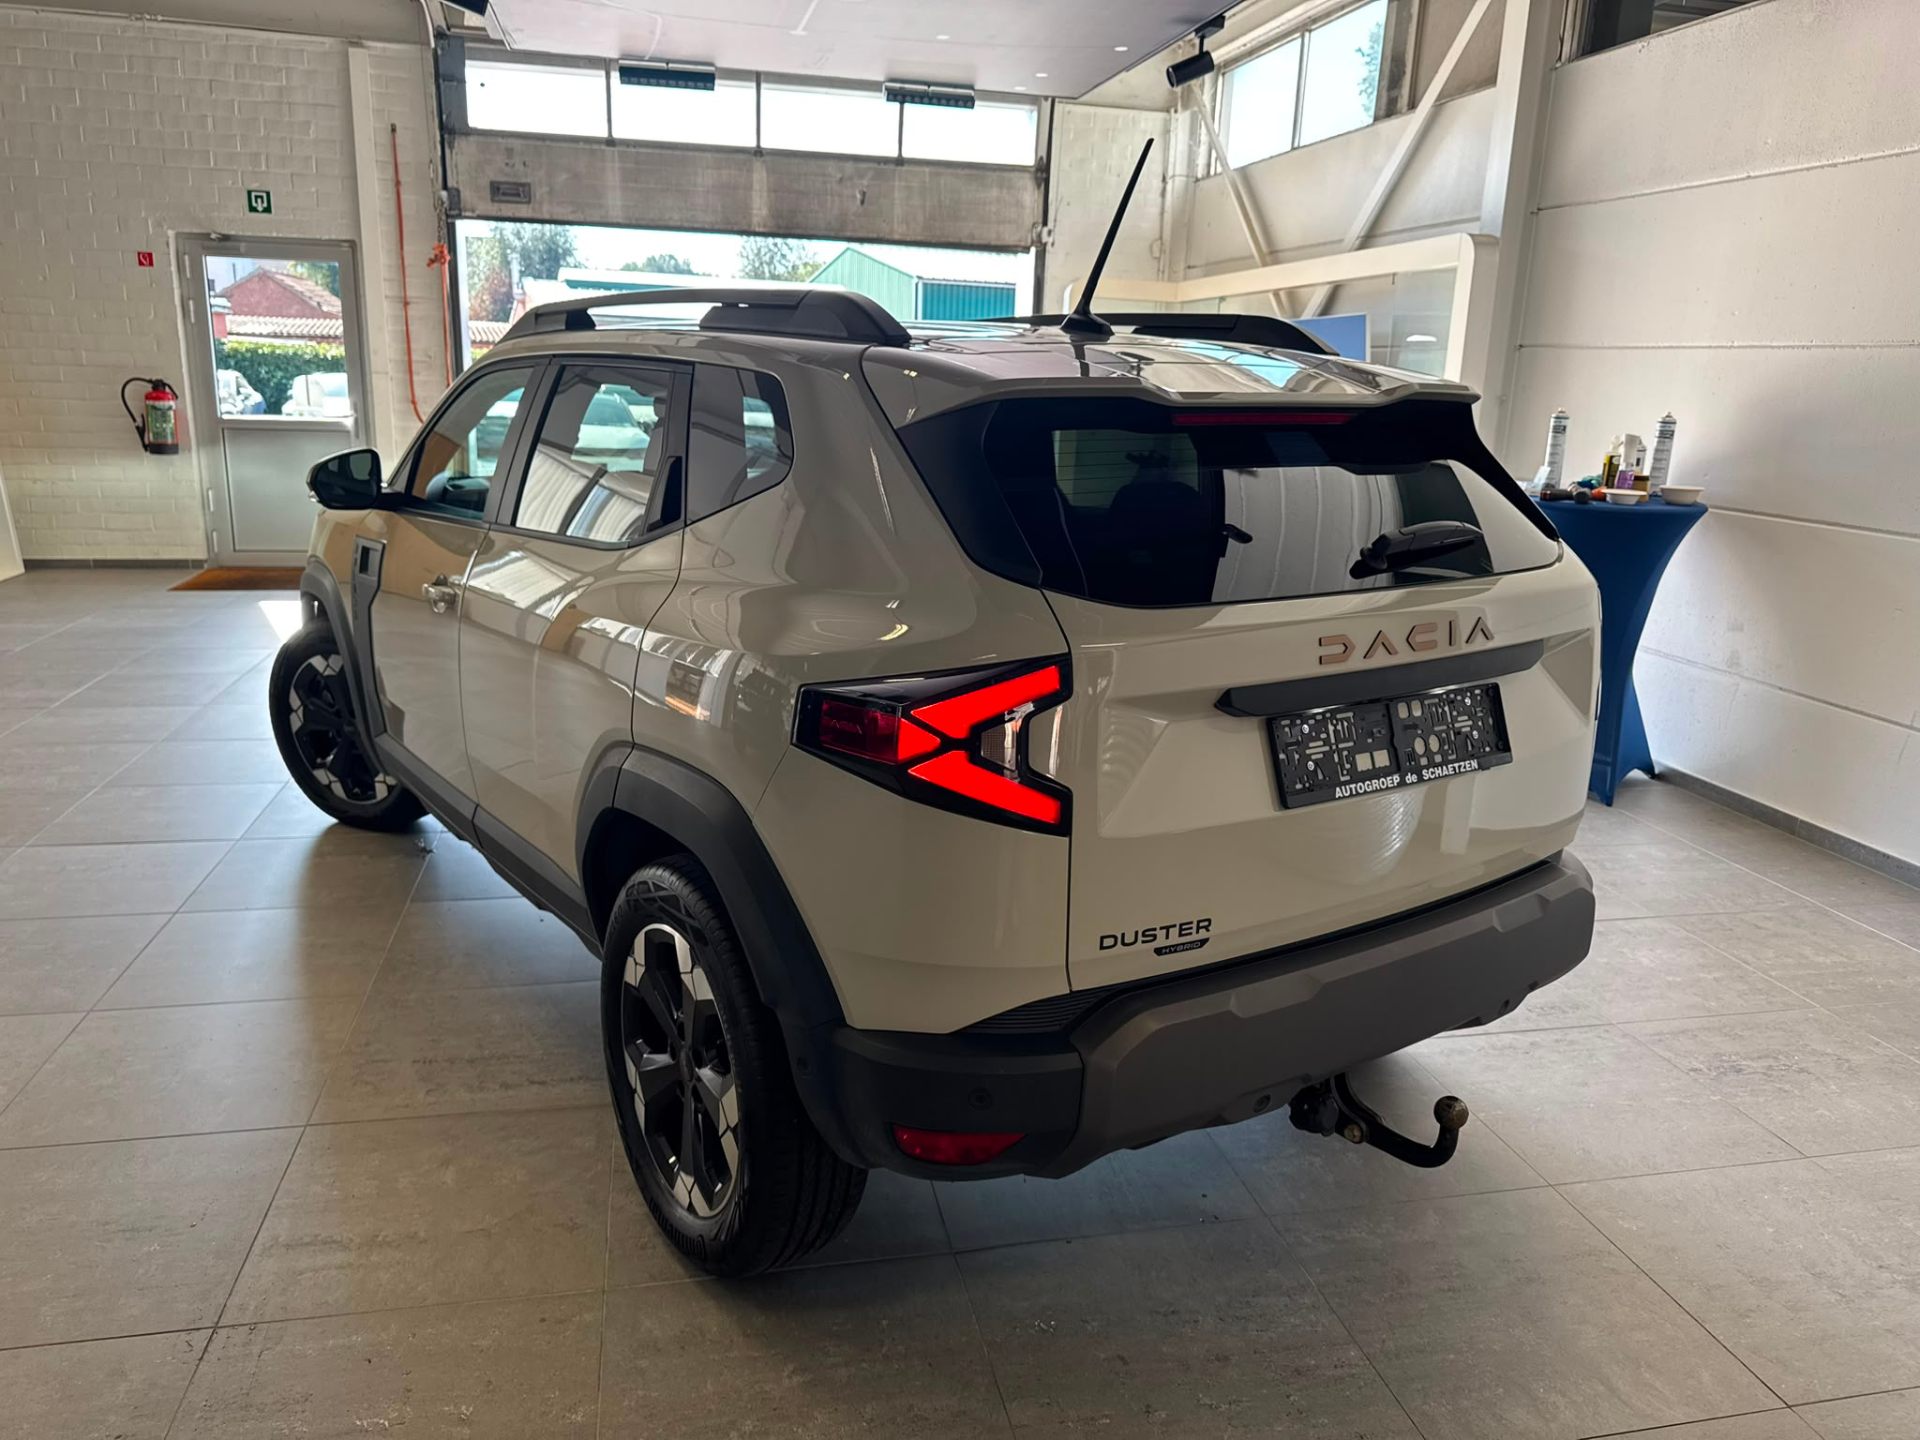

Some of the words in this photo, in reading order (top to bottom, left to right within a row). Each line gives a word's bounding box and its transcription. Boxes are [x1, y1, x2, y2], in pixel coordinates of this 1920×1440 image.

[1318, 616, 1495, 665] DACIA
[1335, 774, 1400, 799] AUTOGROEP
[1405, 772, 1418, 784] de
[1422, 758, 1479, 781] SCHAETZEN
[1099, 917, 1212, 951] DUSTER
[1161, 941, 1202, 955] HYBRID
